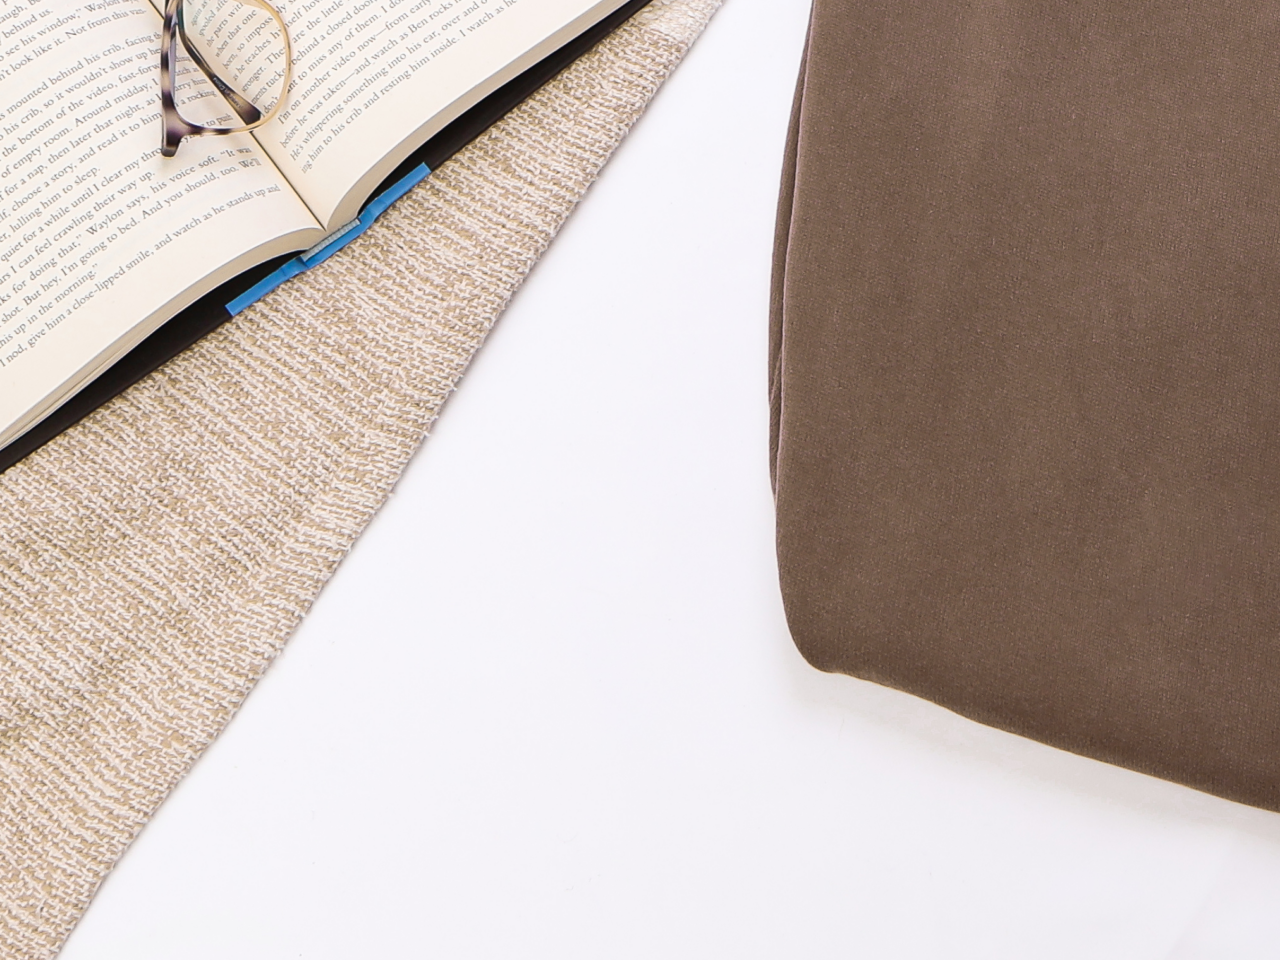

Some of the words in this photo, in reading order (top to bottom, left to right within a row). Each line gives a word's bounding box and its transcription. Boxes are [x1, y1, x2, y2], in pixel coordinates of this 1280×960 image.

[302, 103, 345, 144] whispering
[342, 67, 390, 106] something
[385, 53, 407, 70] into
[405, 41, 423, 55] his
[422, 30, 441, 44] ear,
[440, 14, 461, 32] over
[462, 0, 481, 18] and
[307, 144, 325, 162] him
[322, 135, 333, 146] to
[330, 123, 346, 137] his
[345, 107, 363, 125] crib
[362, 91, 381, 110] and
[379, 70, 412, 96] resting
[407, 56, 431, 73] him
[428, 37, 460, 59] inside.
[466, 11, 495, 33] watch
[494, 5, 505, 15] as
[2, 305, 24, 325] shot.
[21, 289, 42, 307] But
[39, 275, 63, 293] hey,
[78, 241, 108, 266] going
[106, 233, 119, 244] to
[116, 216, 141, 235] bed.
[141, 200, 164, 220] And
[163, 190, 184, 208] you
[184, 171, 220, 194] should,
[219, 166, 240, 176] too.
[5, 343, 28, 364] nod,
[26, 328, 47, 349] give
[44, 313, 67, 331] him
[72, 265, 126, 311] close-lipped
[125, 250, 155, 271] smile,
[153, 233, 173, 251] and
[172, 217, 203, 238] watch
[202, 211, 214, 221] as
[210, 205, 226, 216] he
[225, 191, 255, 209] stands
[253, 188, 267, 198] up
